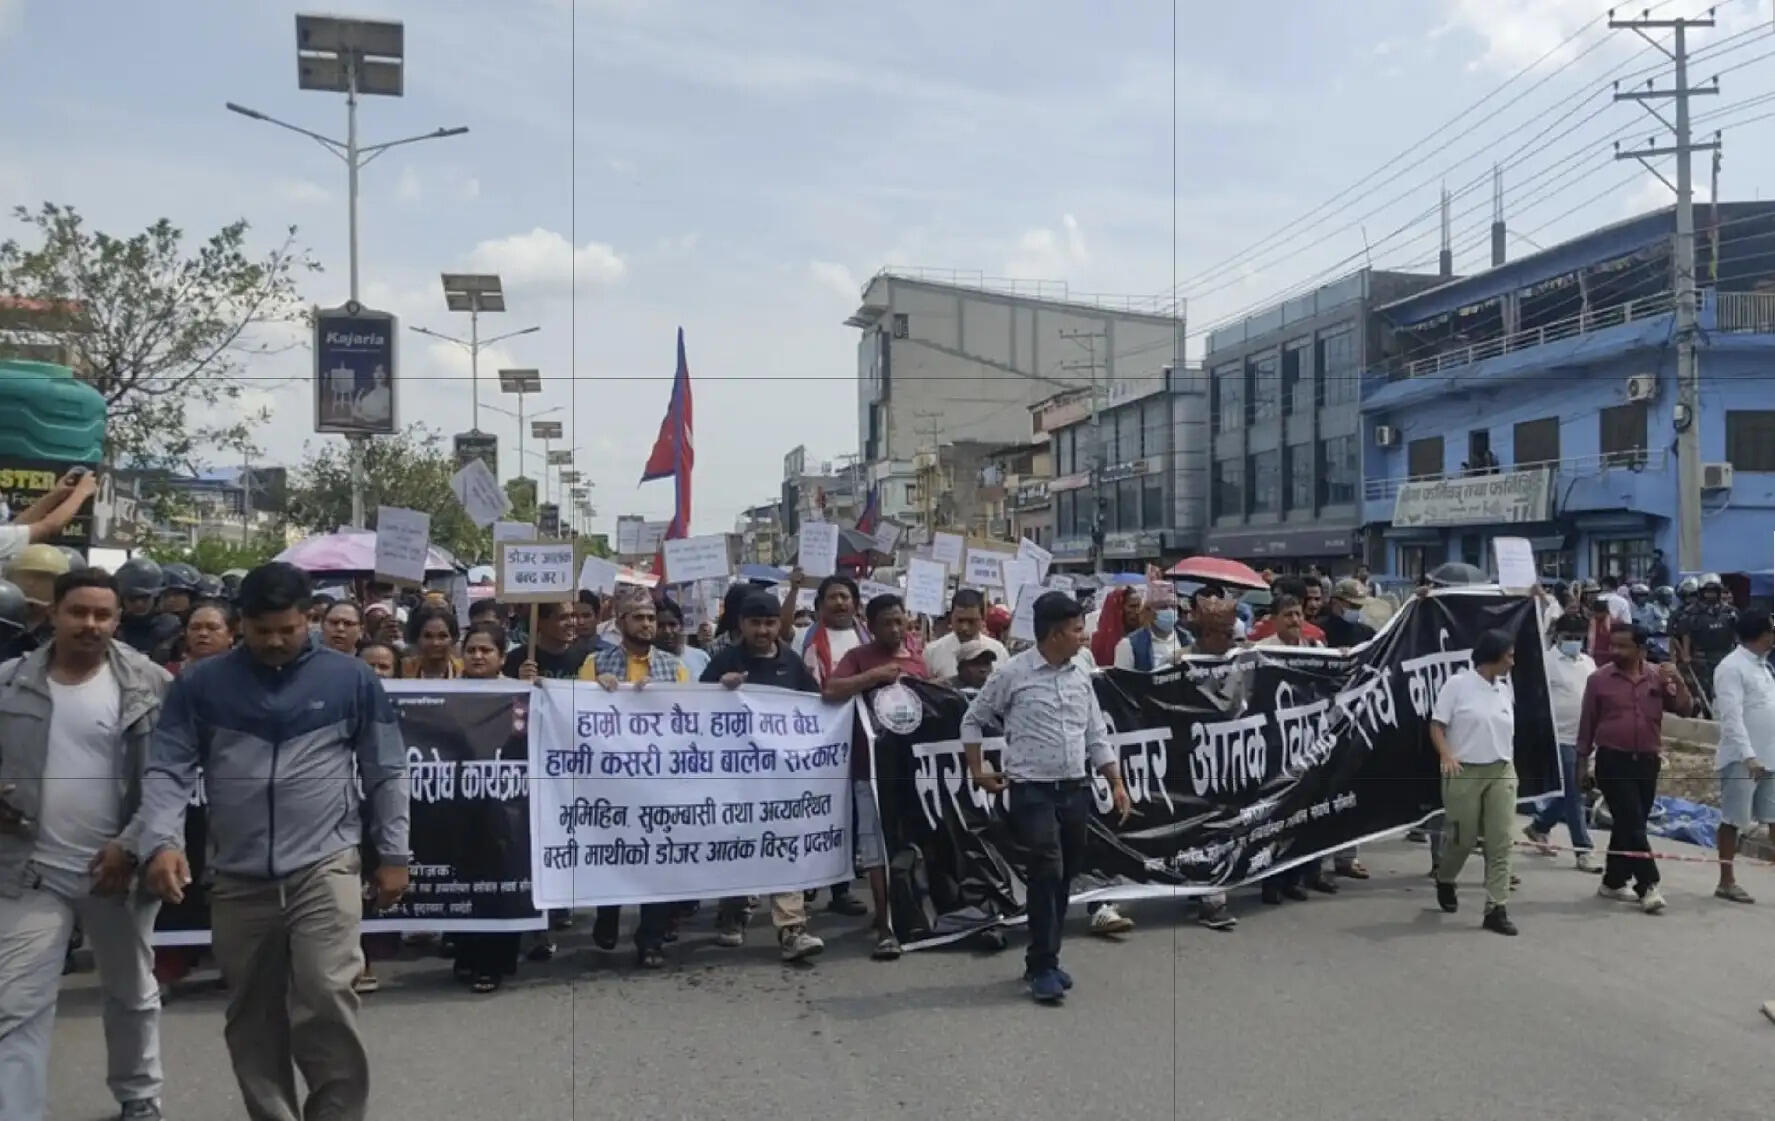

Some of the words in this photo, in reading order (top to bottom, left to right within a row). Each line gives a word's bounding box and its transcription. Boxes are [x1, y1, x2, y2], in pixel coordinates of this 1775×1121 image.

[326, 331, 384, 347] Kajaria
[577, 705, 621, 738] हाम्रो
[629, 713, 663, 736] कर
[710, 704, 753, 737] हाम्रो
[759, 712, 787, 736] मत
[546, 743, 594, 775] हामी
[601, 743, 661, 777] कसरी
[720, 741, 777, 773] बालेन
[638, 797, 716, 833] सुकुम्बासी
[722, 802, 753, 824] तथा
[760, 790, 832, 821] अव्यवस्थित
[543, 837, 579, 870] बस्ती
[585, 837, 651, 866] माथीको
[655, 837, 702, 866] डोजर
[706, 836, 757, 862] आतंक
[803, 824, 844, 857] प्रदर्शन
